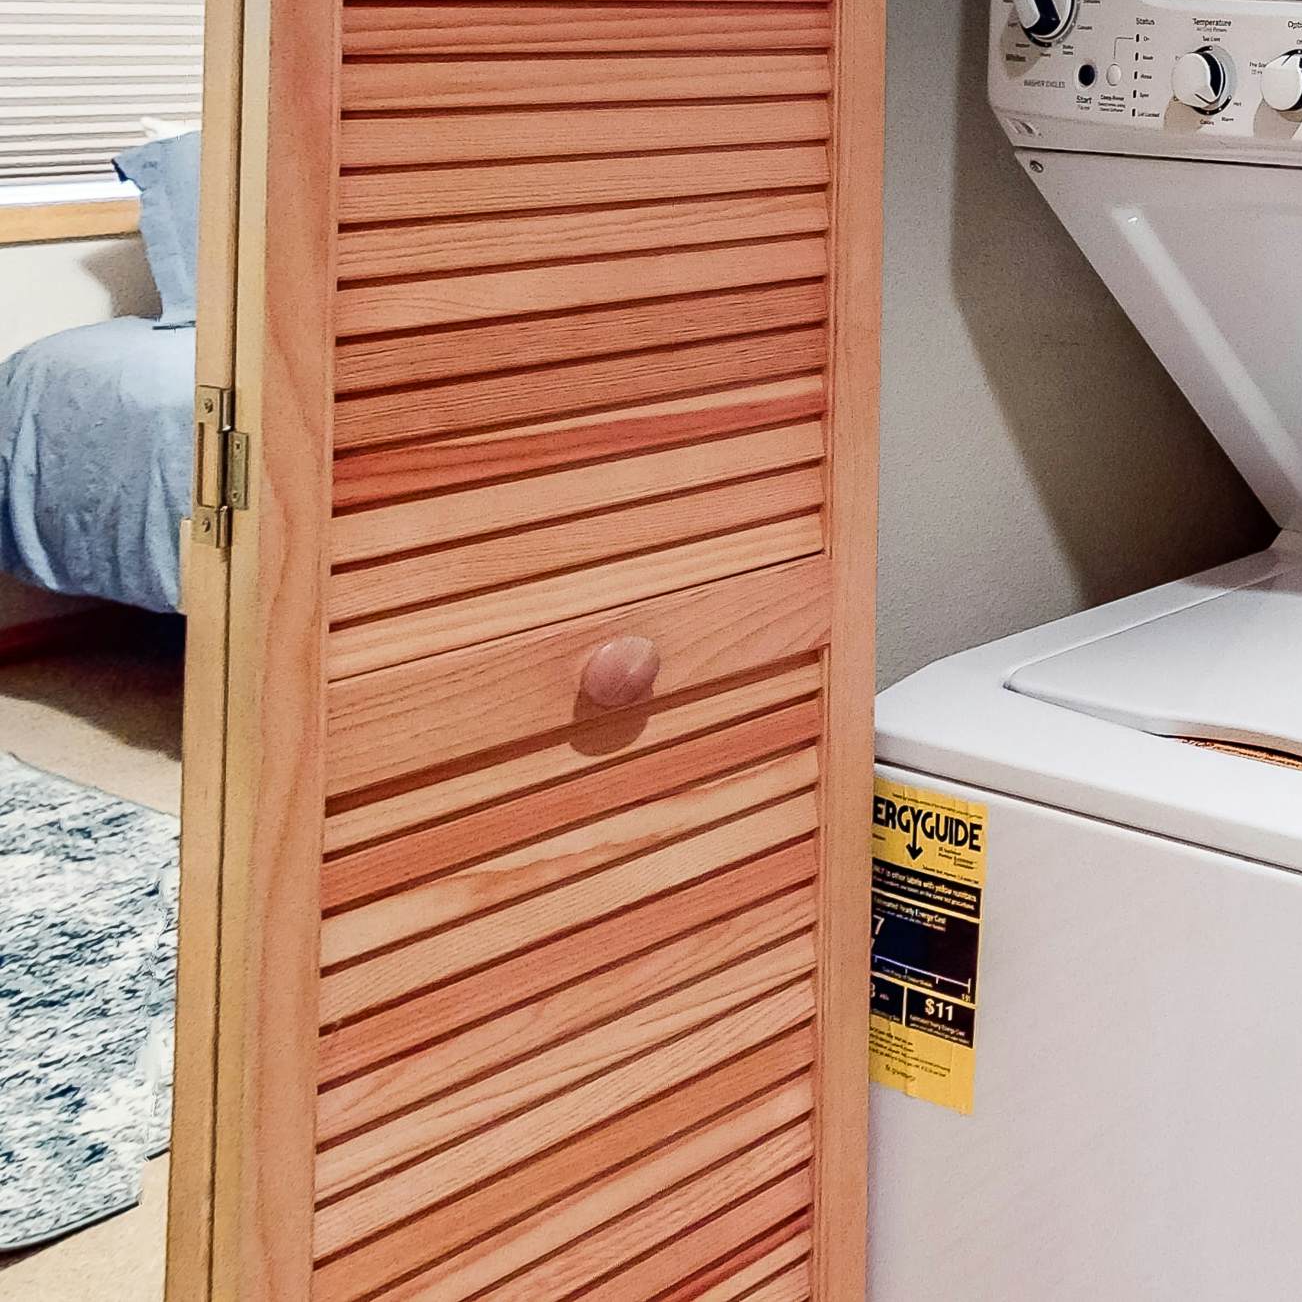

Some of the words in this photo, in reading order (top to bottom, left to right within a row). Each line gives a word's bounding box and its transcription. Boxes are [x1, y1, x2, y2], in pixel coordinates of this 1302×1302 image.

[1136, 17, 1156, 26] Status
[1192, 18, 1232, 29] Temperature
[925, 999, 953, 1021] $11
